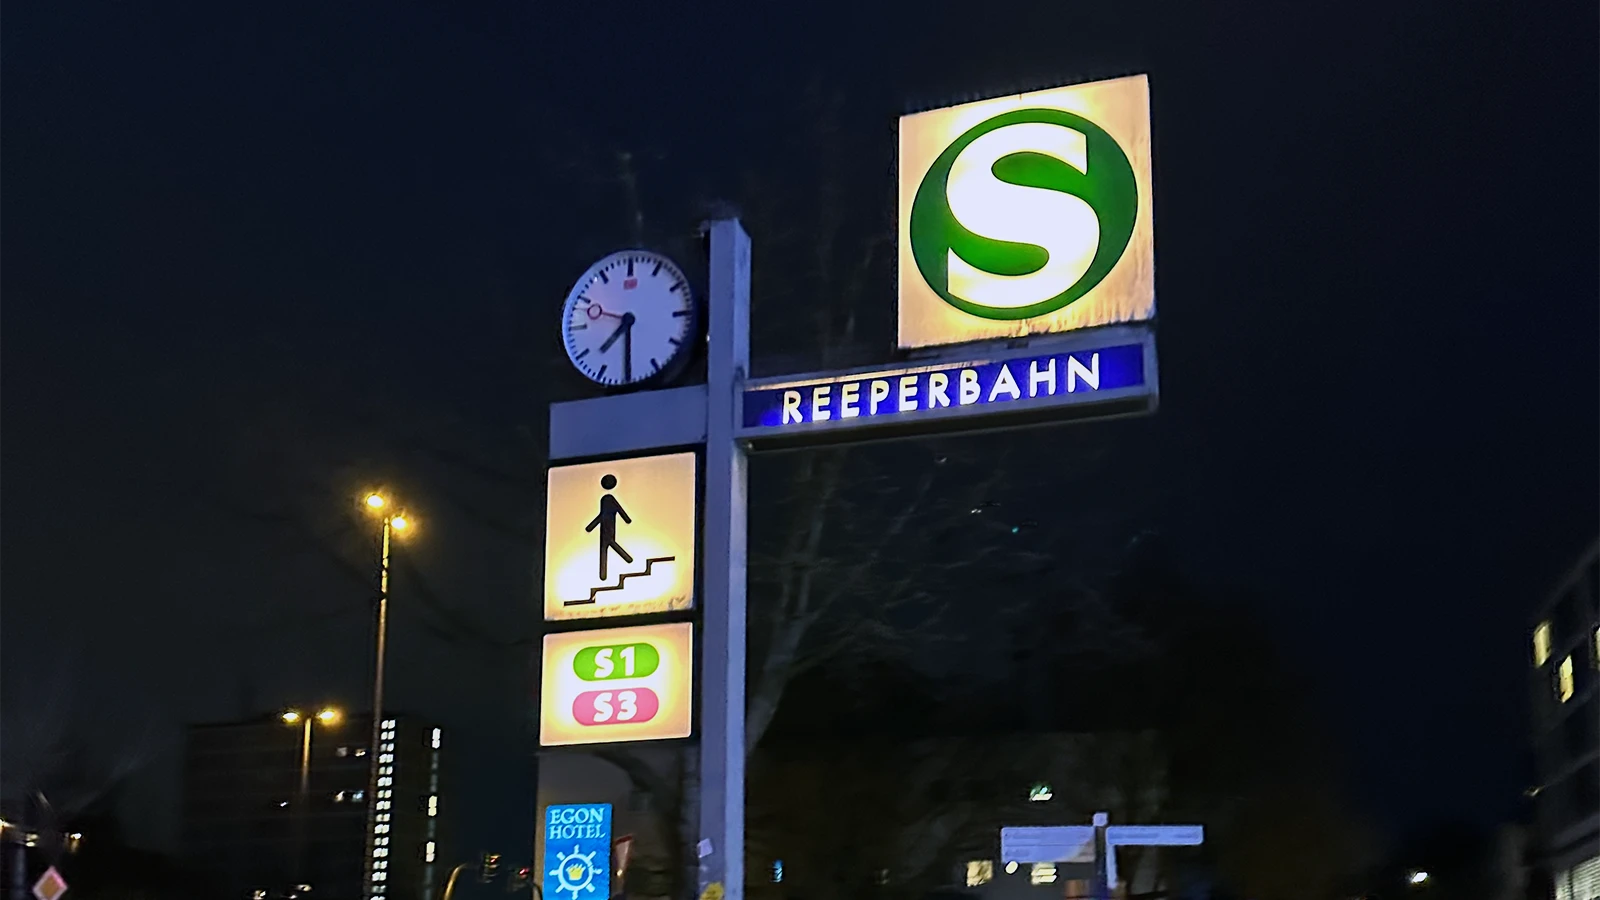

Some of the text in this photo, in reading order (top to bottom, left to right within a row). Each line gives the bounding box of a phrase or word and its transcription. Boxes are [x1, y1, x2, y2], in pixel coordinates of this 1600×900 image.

[946, 122, 1100, 308] S
[781, 353, 1100, 424] REEPERBAHN
[593, 646, 635, 678] S1
[593, 690, 637, 722] S3
[549, 807, 605, 825] EGON
[549, 824, 606, 840] HOTEL
